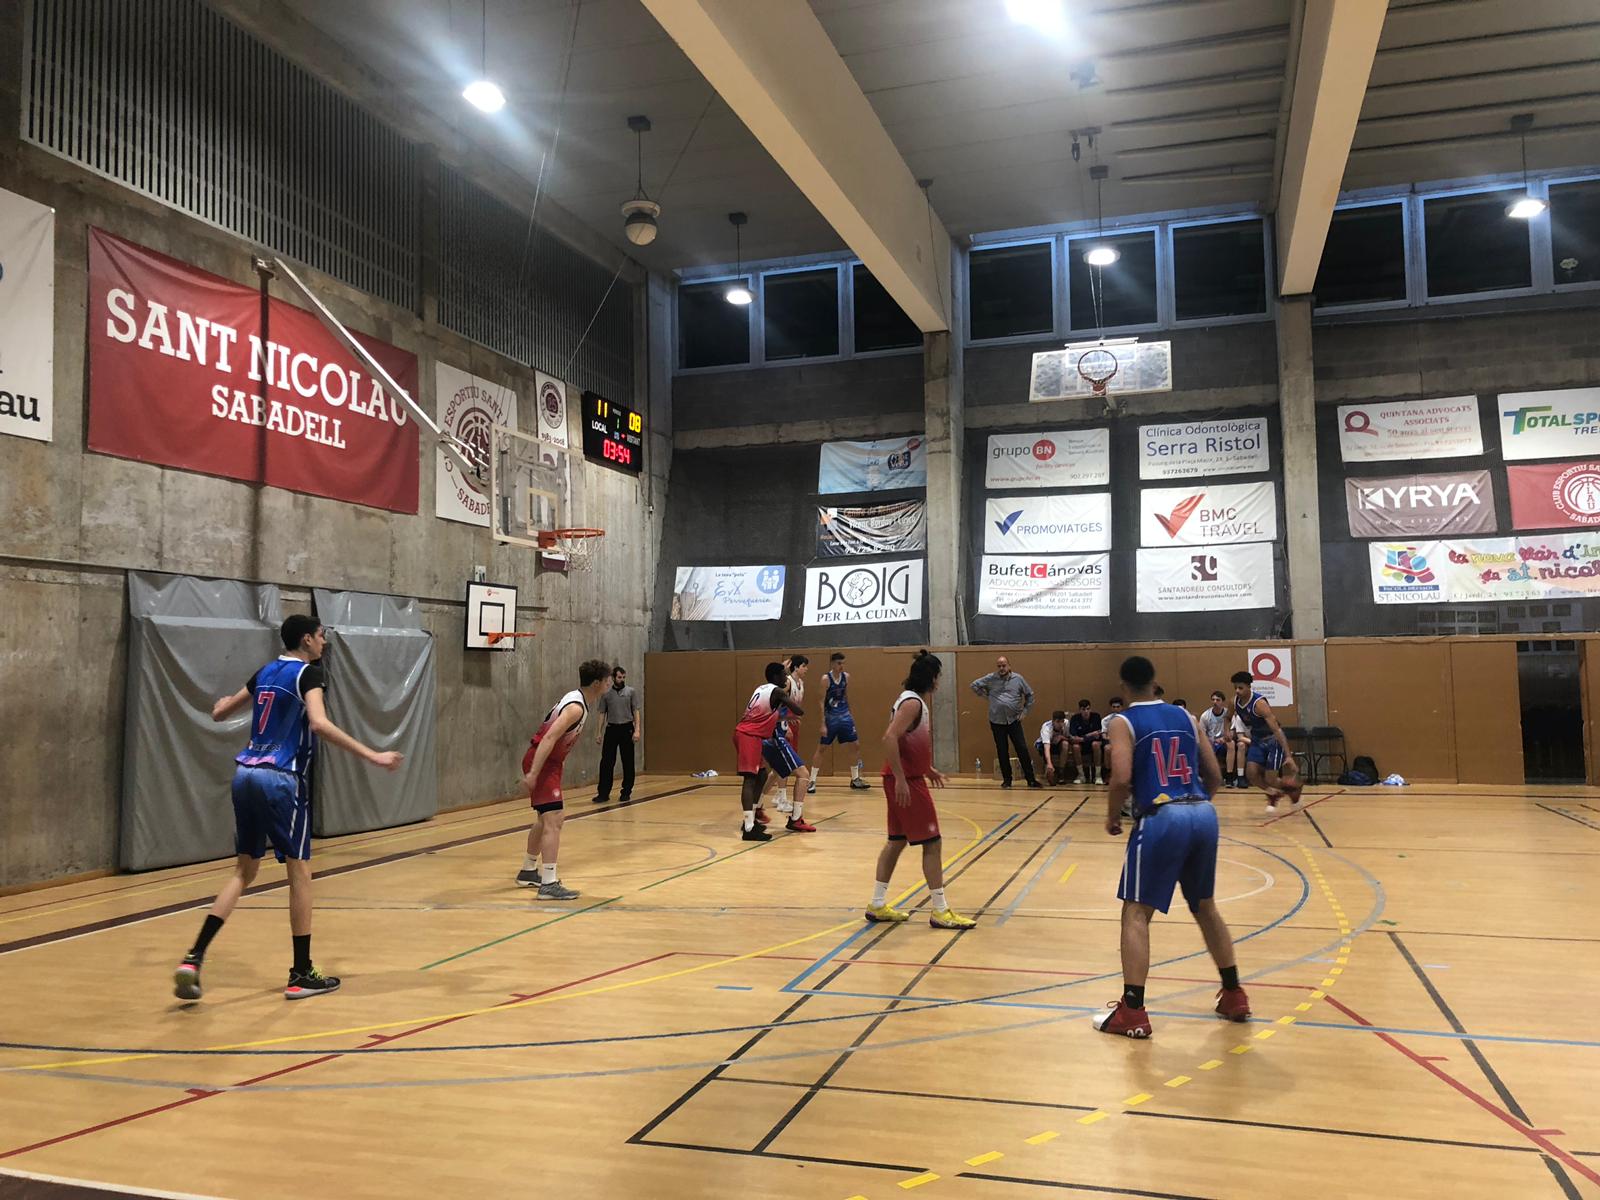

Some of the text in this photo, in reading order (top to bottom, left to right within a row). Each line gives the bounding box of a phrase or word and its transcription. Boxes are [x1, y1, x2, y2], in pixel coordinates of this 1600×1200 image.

[106, 288, 237, 373] SANT
[211, 384, 346, 449] SABADELL
[597, 399, 608, 418] 11
[1380, 404, 1473, 420] QUINTANA ADVOCATS
[591, 420, 608, 434] LOCAL
[628, 412, 642, 433] 08
[1146, 421, 1260, 438] Clínica Odontològica
[1403, 416, 1451, 427] ASSOCIATS
[603, 439, 631, 465] 03:54
[992, 446, 1052, 459] grupo BN
[1146, 433, 1260, 457] Serra Ristol
[1552, 464, 1587, 490] ESPORTIU
[1199, 508, 1238, 522] BMC
[1016, 521, 1103, 535] PROMOVIATGES
[1199, 521, 1264, 538] TRAVEL
[816, 564, 909, 610] BOIG
[989, 578, 1040, 588] ADVOCATS
[1158, 583, 1252, 594] SANTANDREU CONSULTORS
[1394, 591, 1440, 601] NICOLAU
[816, 608, 907, 622] PER LA CUINA
[257, 691, 276, 735] 7
[1151, 736, 1193, 787] 14
